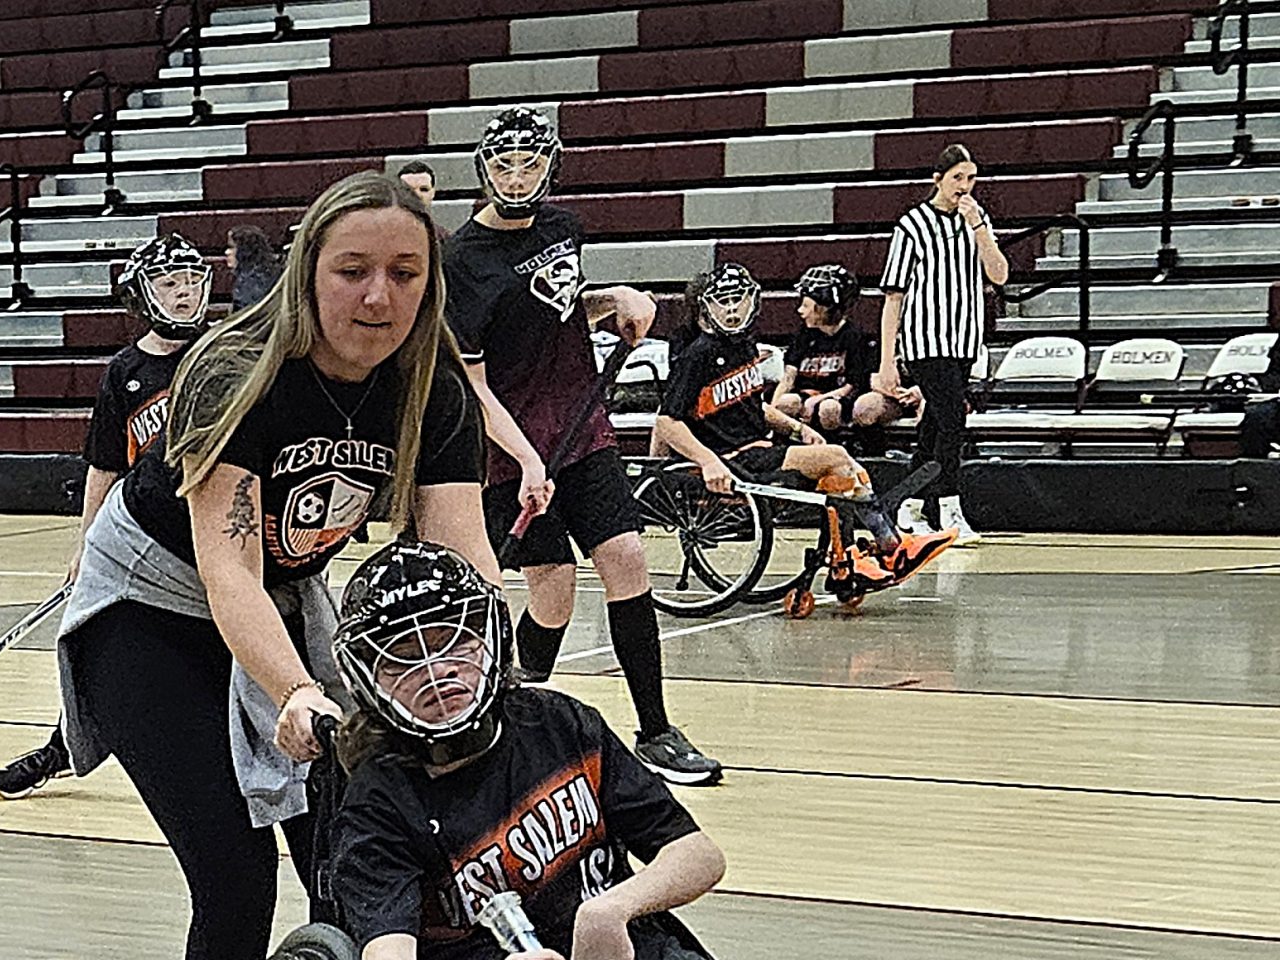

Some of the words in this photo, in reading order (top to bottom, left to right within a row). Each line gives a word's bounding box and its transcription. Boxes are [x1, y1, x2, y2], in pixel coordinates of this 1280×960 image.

[513, 238, 577, 275] HOLMEN
[1014, 346, 1077, 359] HOLMEN
[1110, 350, 1177, 364] HOLMEN
[712, 371, 748, 406] WEST
[131, 398, 169, 447] WEST
[271, 437, 333, 478] WEST
[508, 776, 599, 882] SALEM
